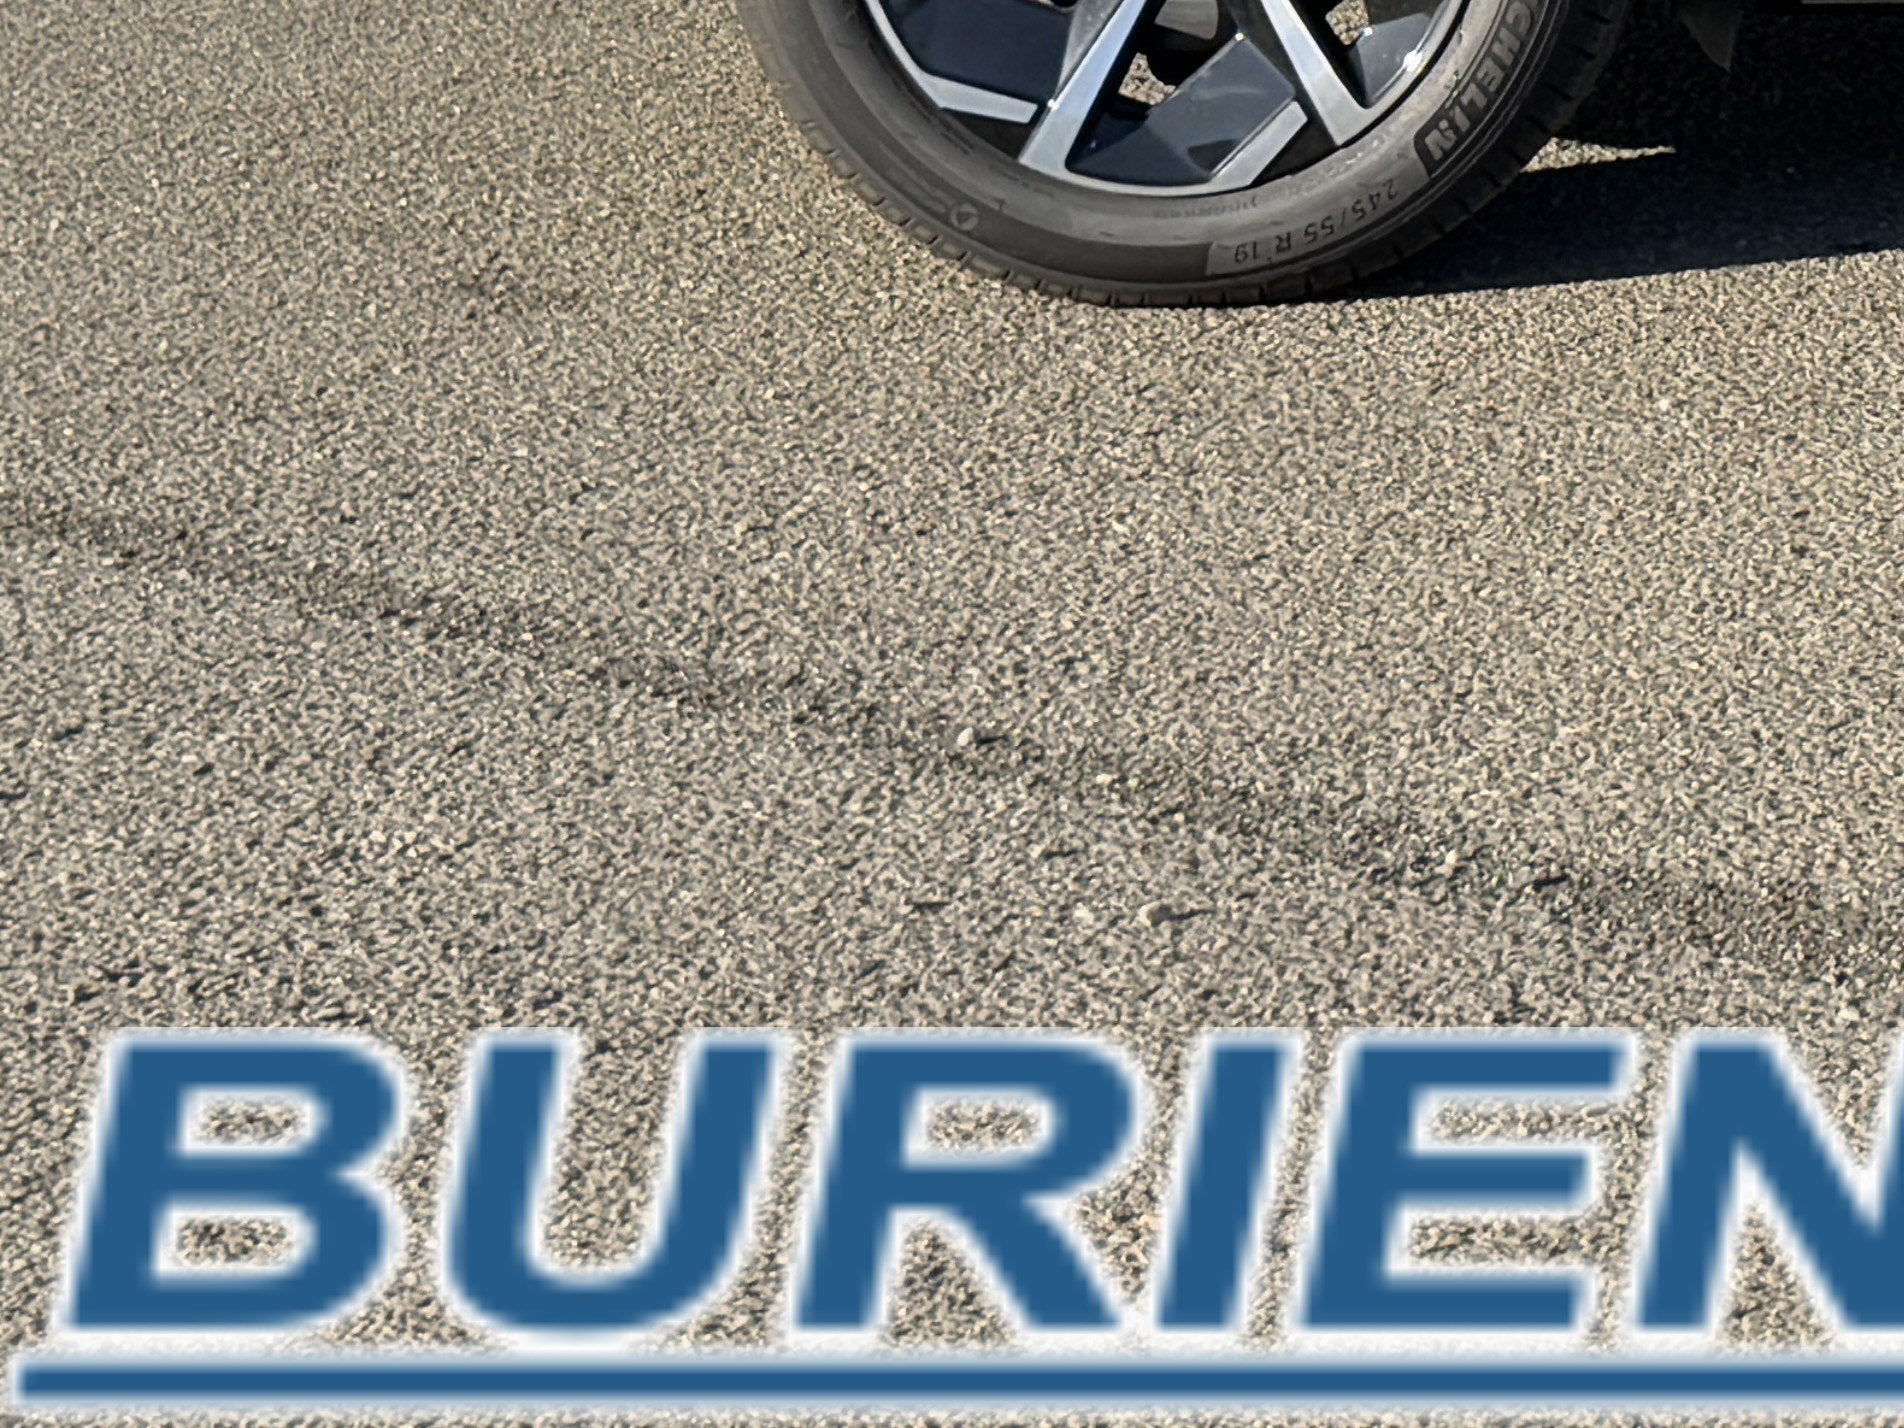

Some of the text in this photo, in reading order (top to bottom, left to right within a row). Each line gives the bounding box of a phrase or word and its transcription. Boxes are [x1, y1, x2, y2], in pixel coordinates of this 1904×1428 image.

[1233, 178, 1400, 264] 245/55 R 19
